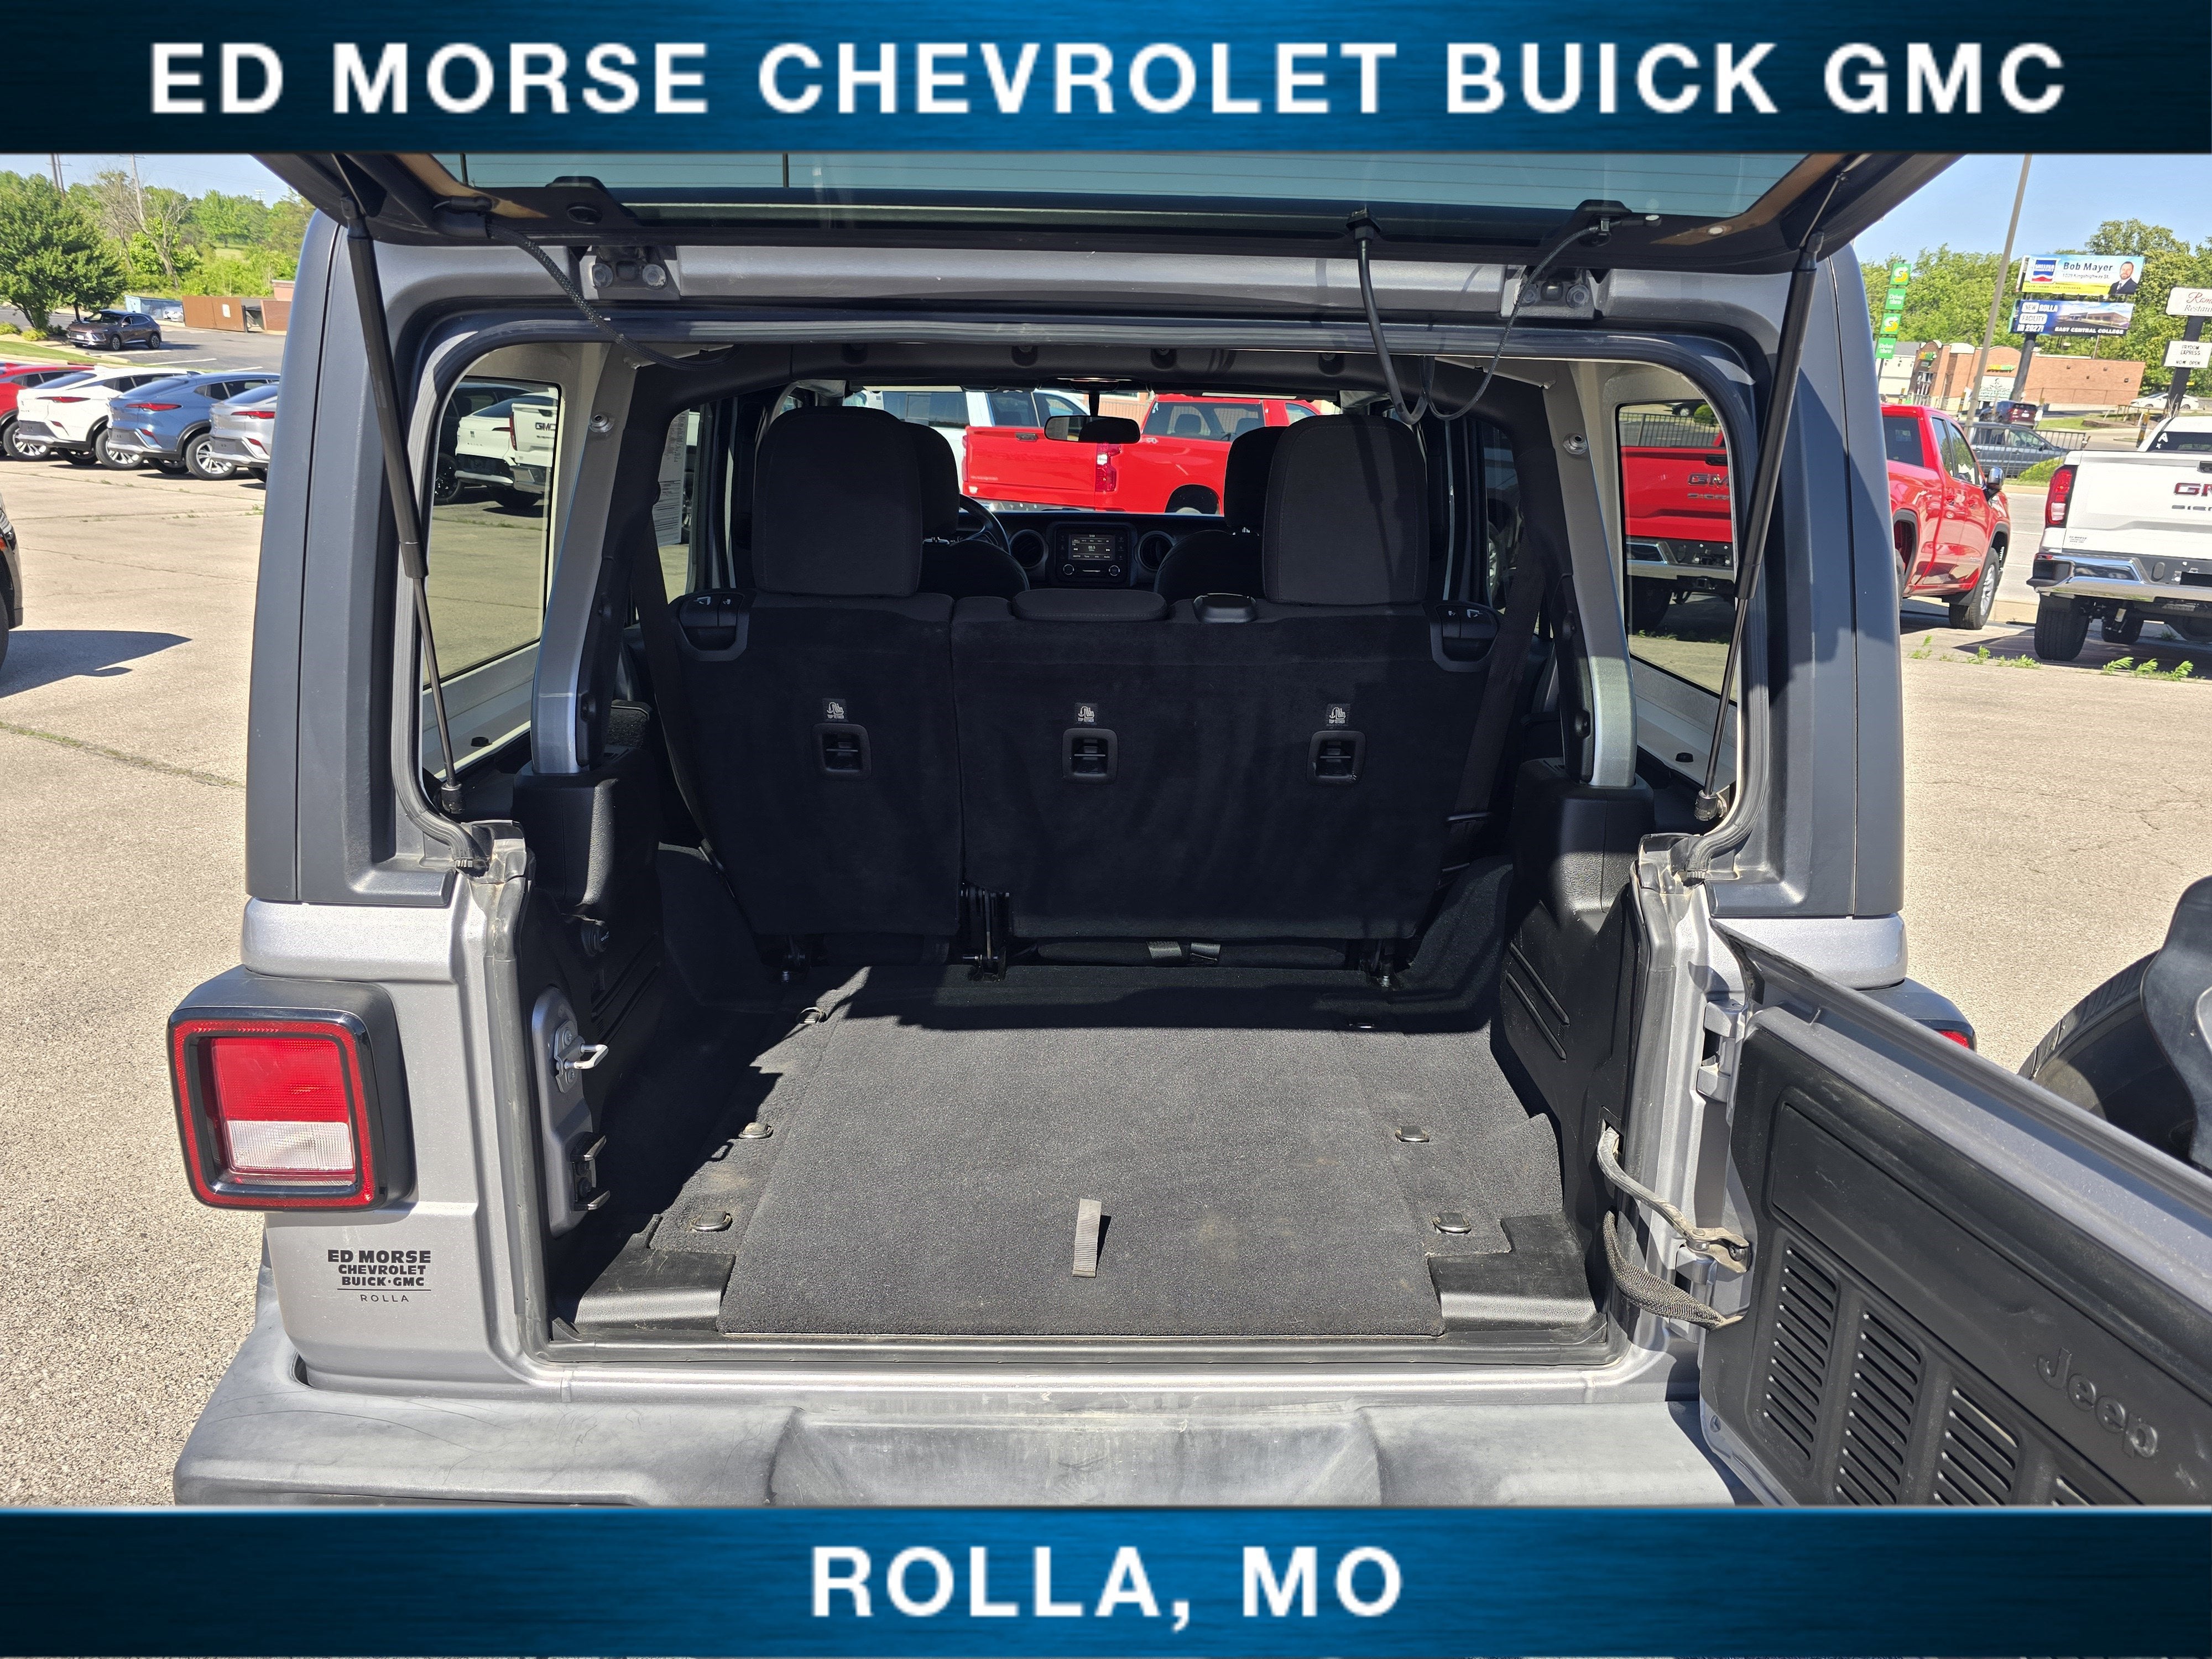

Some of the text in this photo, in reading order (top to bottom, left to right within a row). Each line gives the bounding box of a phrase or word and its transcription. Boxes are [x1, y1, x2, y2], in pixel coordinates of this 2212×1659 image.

[2063, 262, 2113, 273] Bob Mayer
[328, 1249, 431, 1264] ED MORSE
[338, 1264, 426, 1275] CHEVROLET
[360, 1294, 409, 1302] ROLLA
[2037, 1347, 2158, 1459] Jeep
